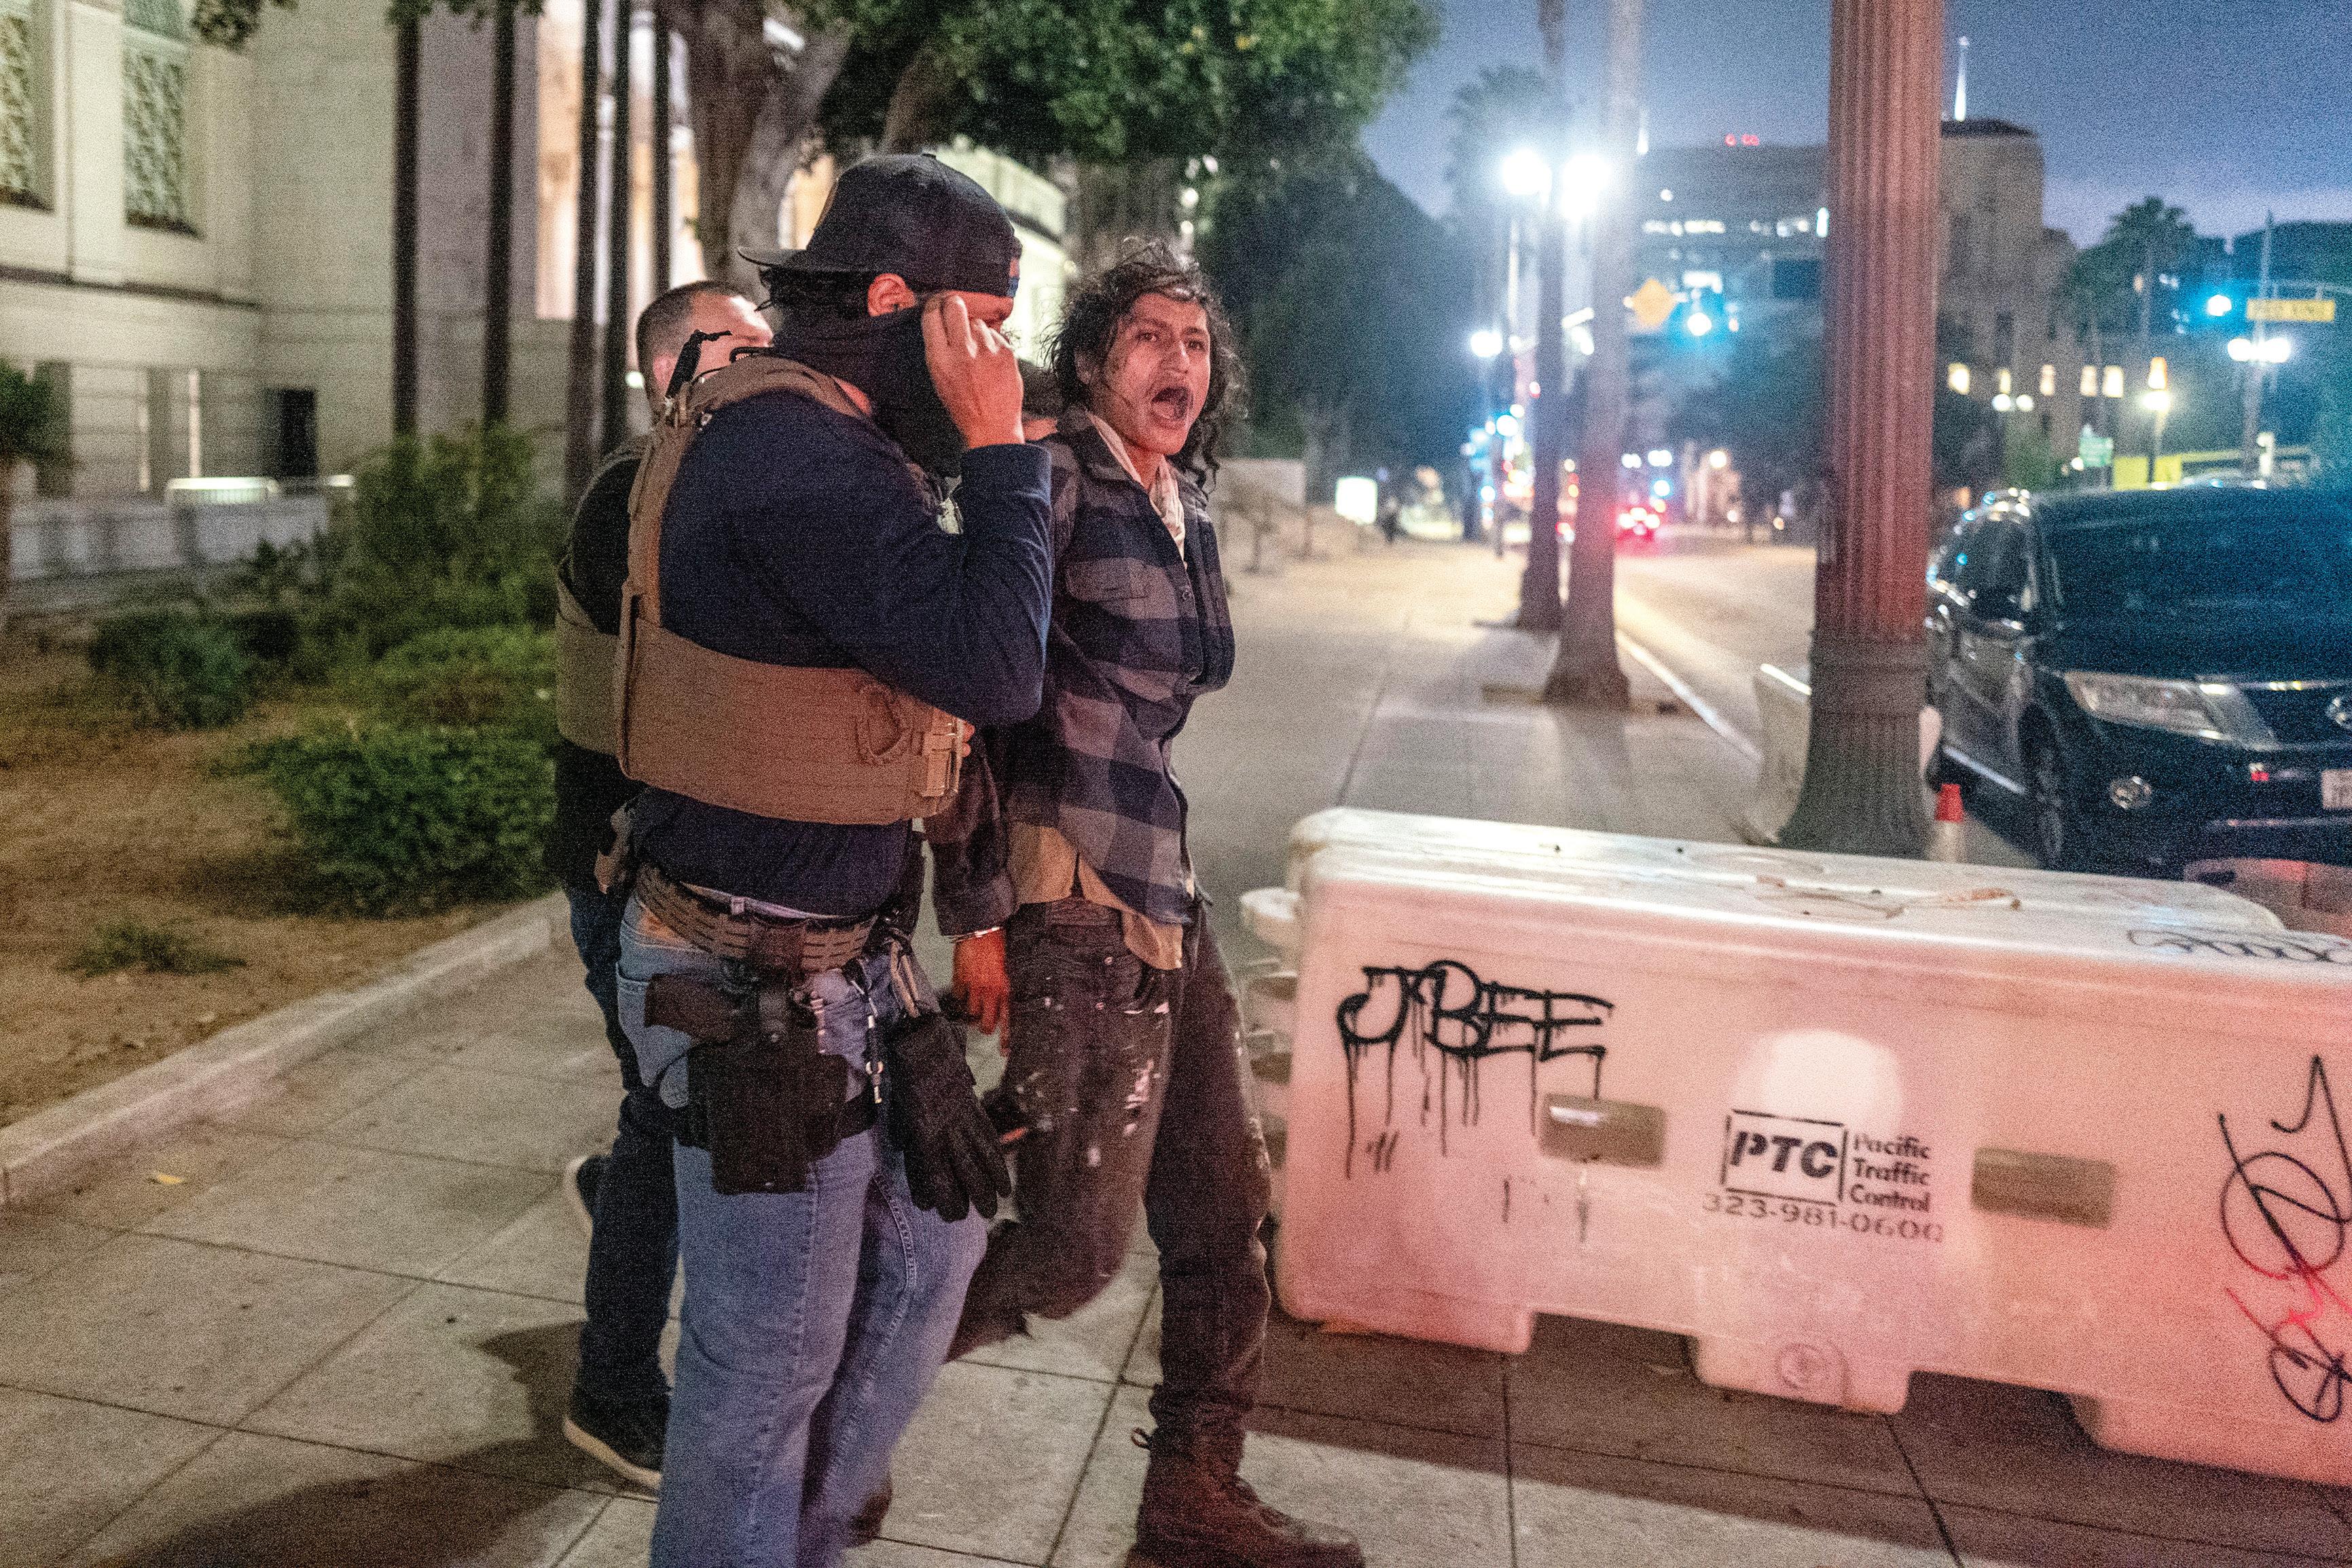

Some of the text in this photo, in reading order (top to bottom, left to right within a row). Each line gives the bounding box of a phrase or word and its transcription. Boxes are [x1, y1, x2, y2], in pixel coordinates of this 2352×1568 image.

[1731, 1131, 1838, 1178] PTC
[1853, 1133, 1930, 1159] Pacific
[1853, 1156, 1930, 1185] Traffic
[1849, 1184, 1930, 1213] Control
[1702, 1193, 1943, 1243] 323-981-0600
